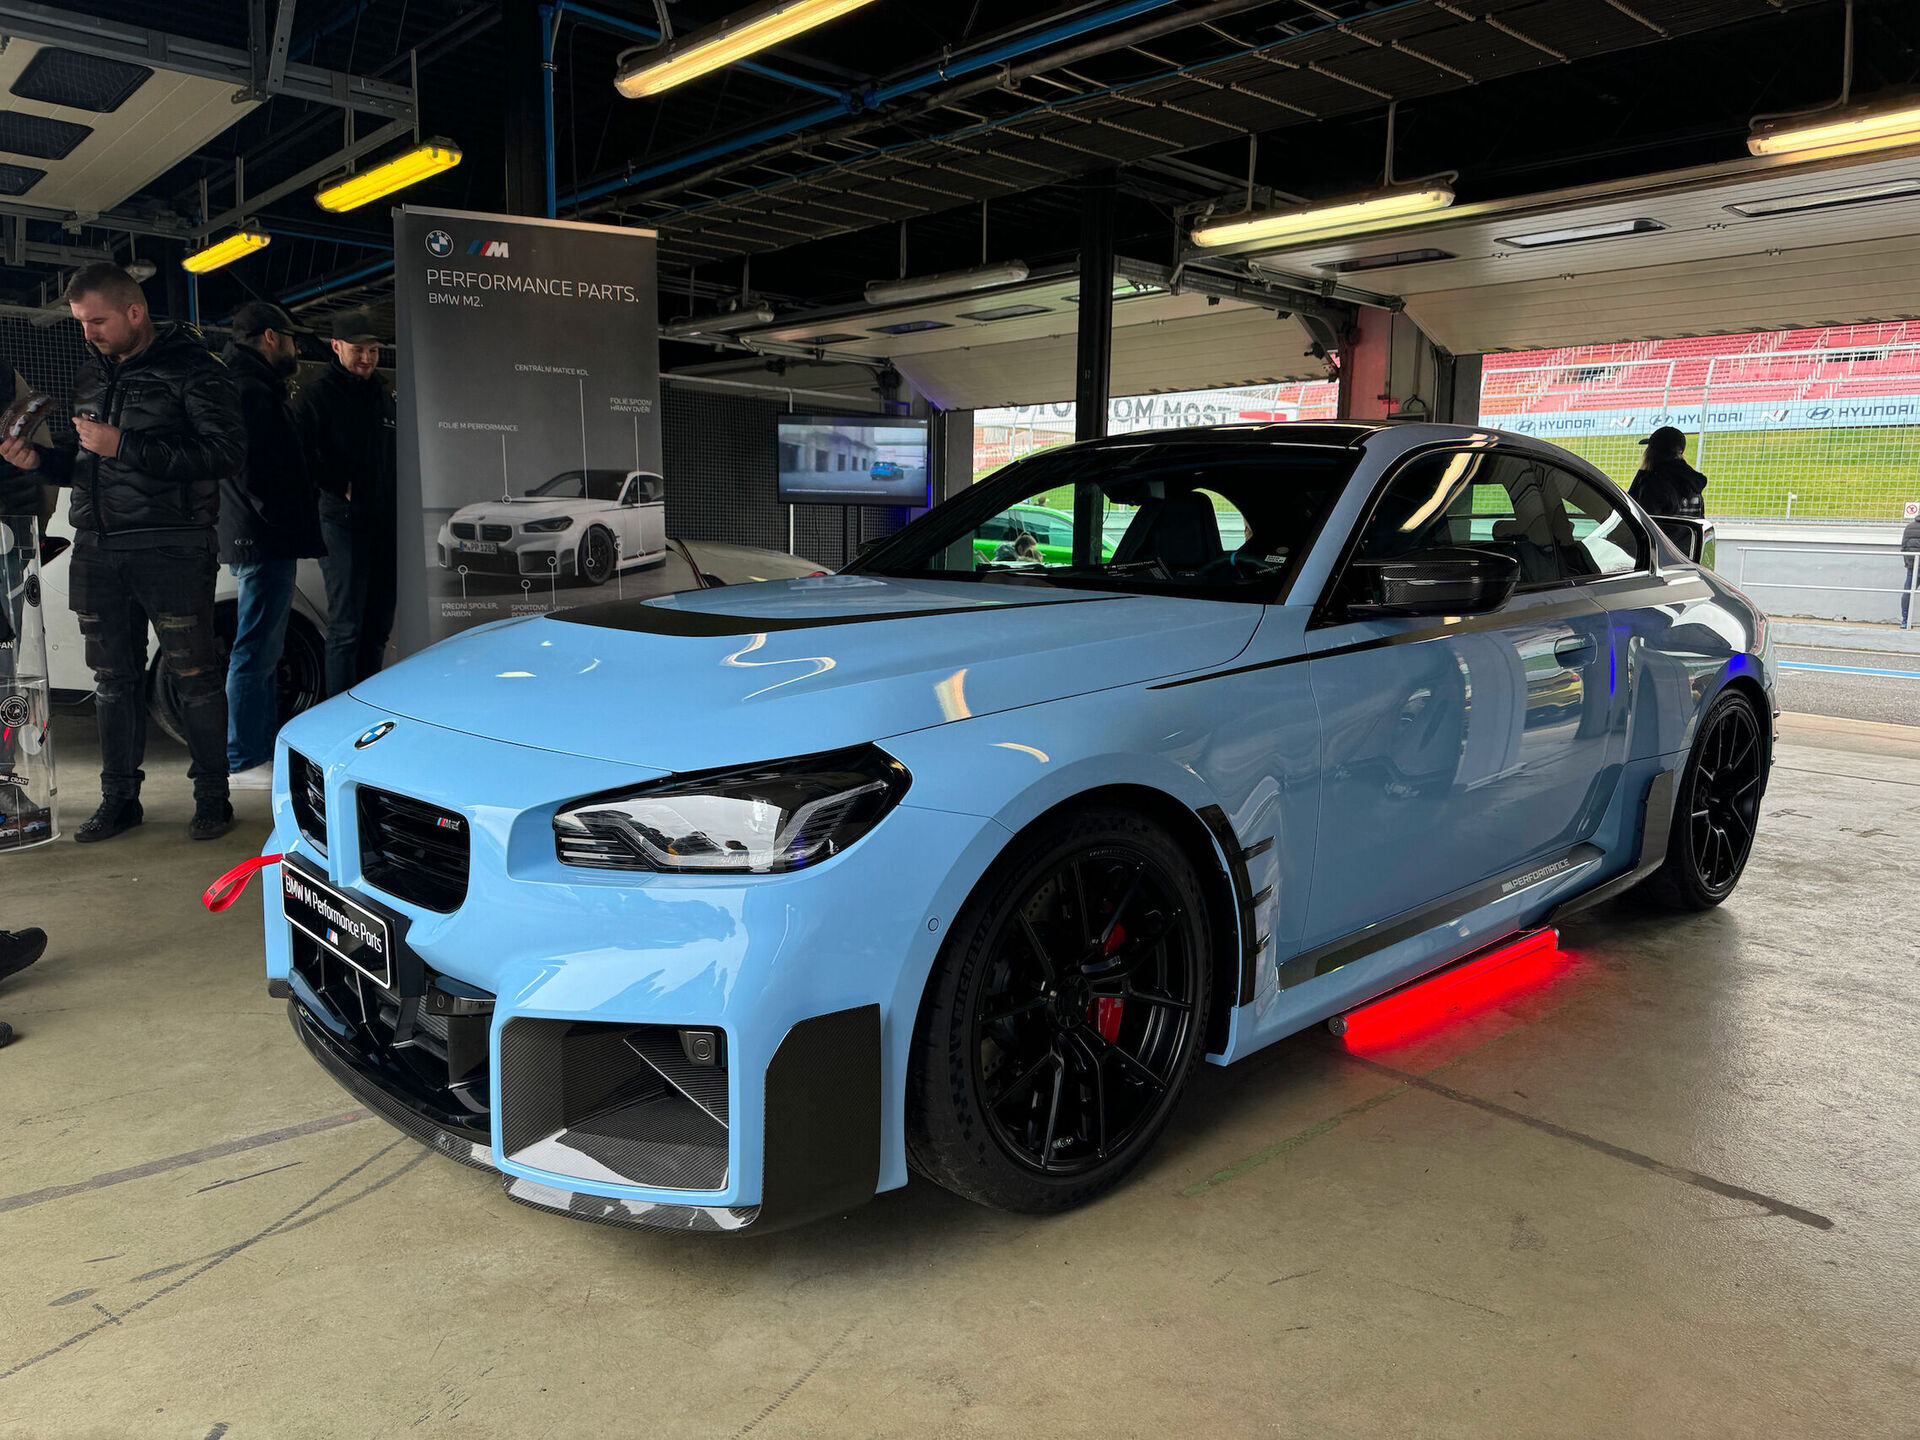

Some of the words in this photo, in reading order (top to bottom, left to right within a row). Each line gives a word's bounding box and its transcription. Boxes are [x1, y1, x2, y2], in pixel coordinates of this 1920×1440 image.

[426, 269, 573, 297] PERFORMANCE
[578, 282, 639, 303] PARTS.
[428, 292, 460, 306] BMW
[463, 295, 484, 307] M2.
[552, 366, 576, 375] MATICE
[1163, 399, 1232, 428] MOST
[1838, 404, 1915, 417] HYUNDAI
[1539, 418, 1596, 431] HYUNDAI
[1677, 412, 1743, 424] HYUNDAI
[467, 422, 519, 432] PERFORMANCE
[442, 610, 472, 618] KARBON
[1512, 858, 1570, 887] PERFORMANCE
[285, 874, 304, 901] BMW
[304, 886, 312, 907] M
[312, 891, 360, 938] Performance
[360, 922, 383, 953] Parts
